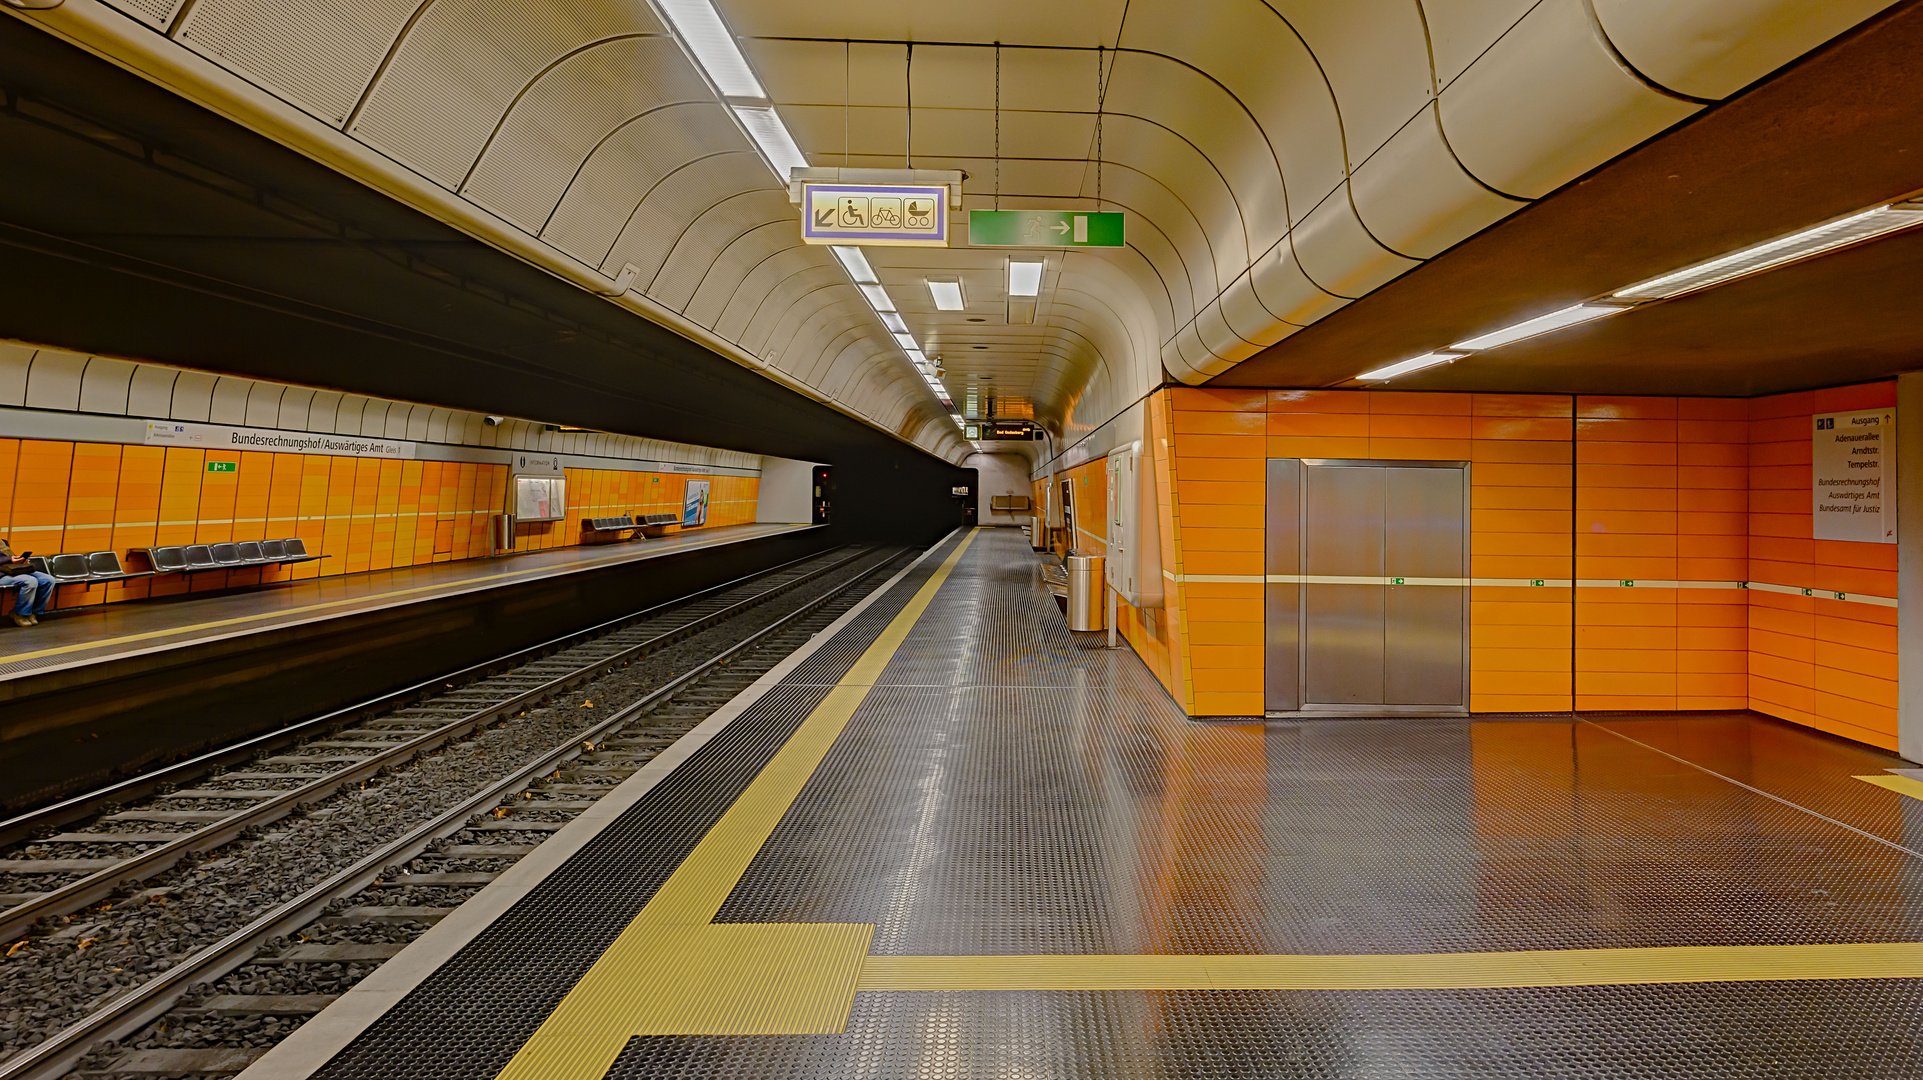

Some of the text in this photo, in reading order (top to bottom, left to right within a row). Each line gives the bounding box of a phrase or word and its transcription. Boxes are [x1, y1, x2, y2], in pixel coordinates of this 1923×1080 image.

[1852, 417, 1879, 426] Ausgang
[1835, 433, 1879, 443] Adenauerallee
[369, 442, 384, 454] Amt
[385, 446, 397, 454] Gleis
[1852, 447, 1879, 455] Arndtstr.
[1848, 460, 1879, 469] Tempelstr.
[1818, 477, 1880, 487] Bundesrechnungshof
[1828, 491, 1880, 501] Auswärtiges Amt
[1819, 504, 1880, 514] Bundesamt für Justiz
